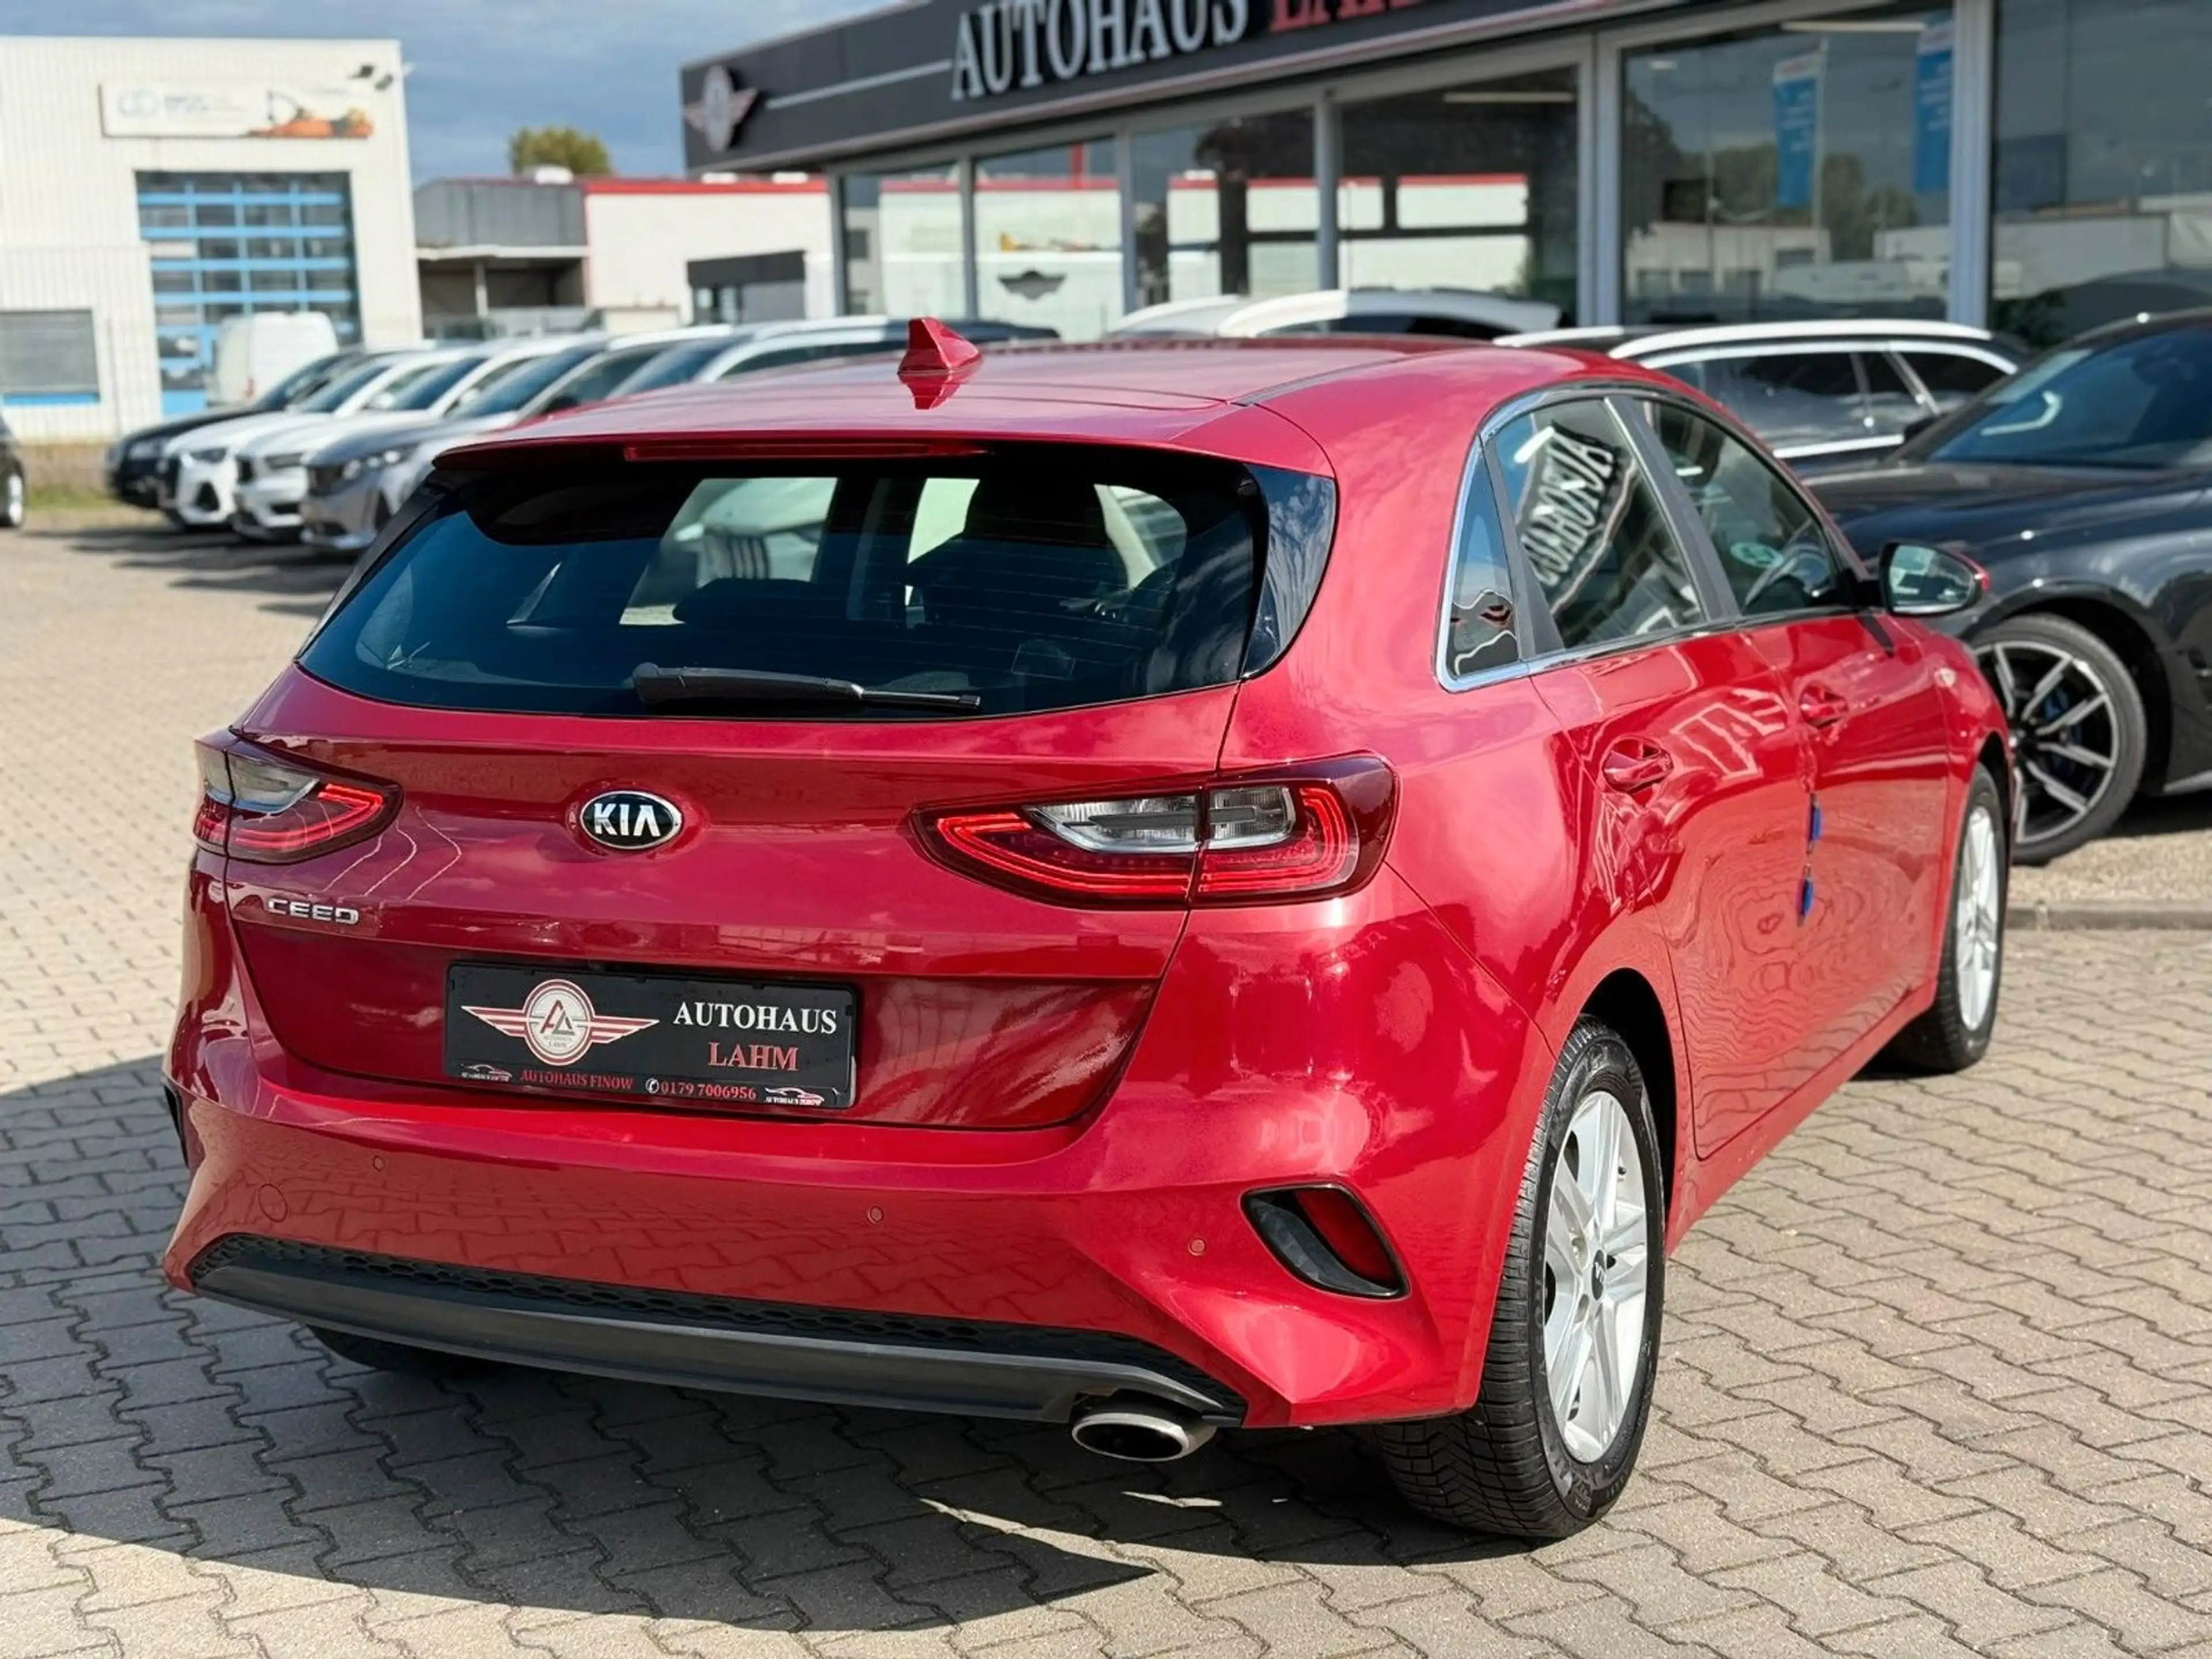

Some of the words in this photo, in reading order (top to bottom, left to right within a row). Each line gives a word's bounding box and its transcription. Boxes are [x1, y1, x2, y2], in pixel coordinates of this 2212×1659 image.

[594, 803, 661, 837] KIA
[267, 897, 359, 925] CEED
[673, 1001, 837, 1034] AUTOHAUS
[708, 1041, 799, 1071] LAHM
[520, 1069, 587, 1086] AUTOHAUS
[590, 1075, 634, 1090] FINOW
[661, 1081, 695, 1095] 0179
[698, 1084, 756, 1101] 7006956
